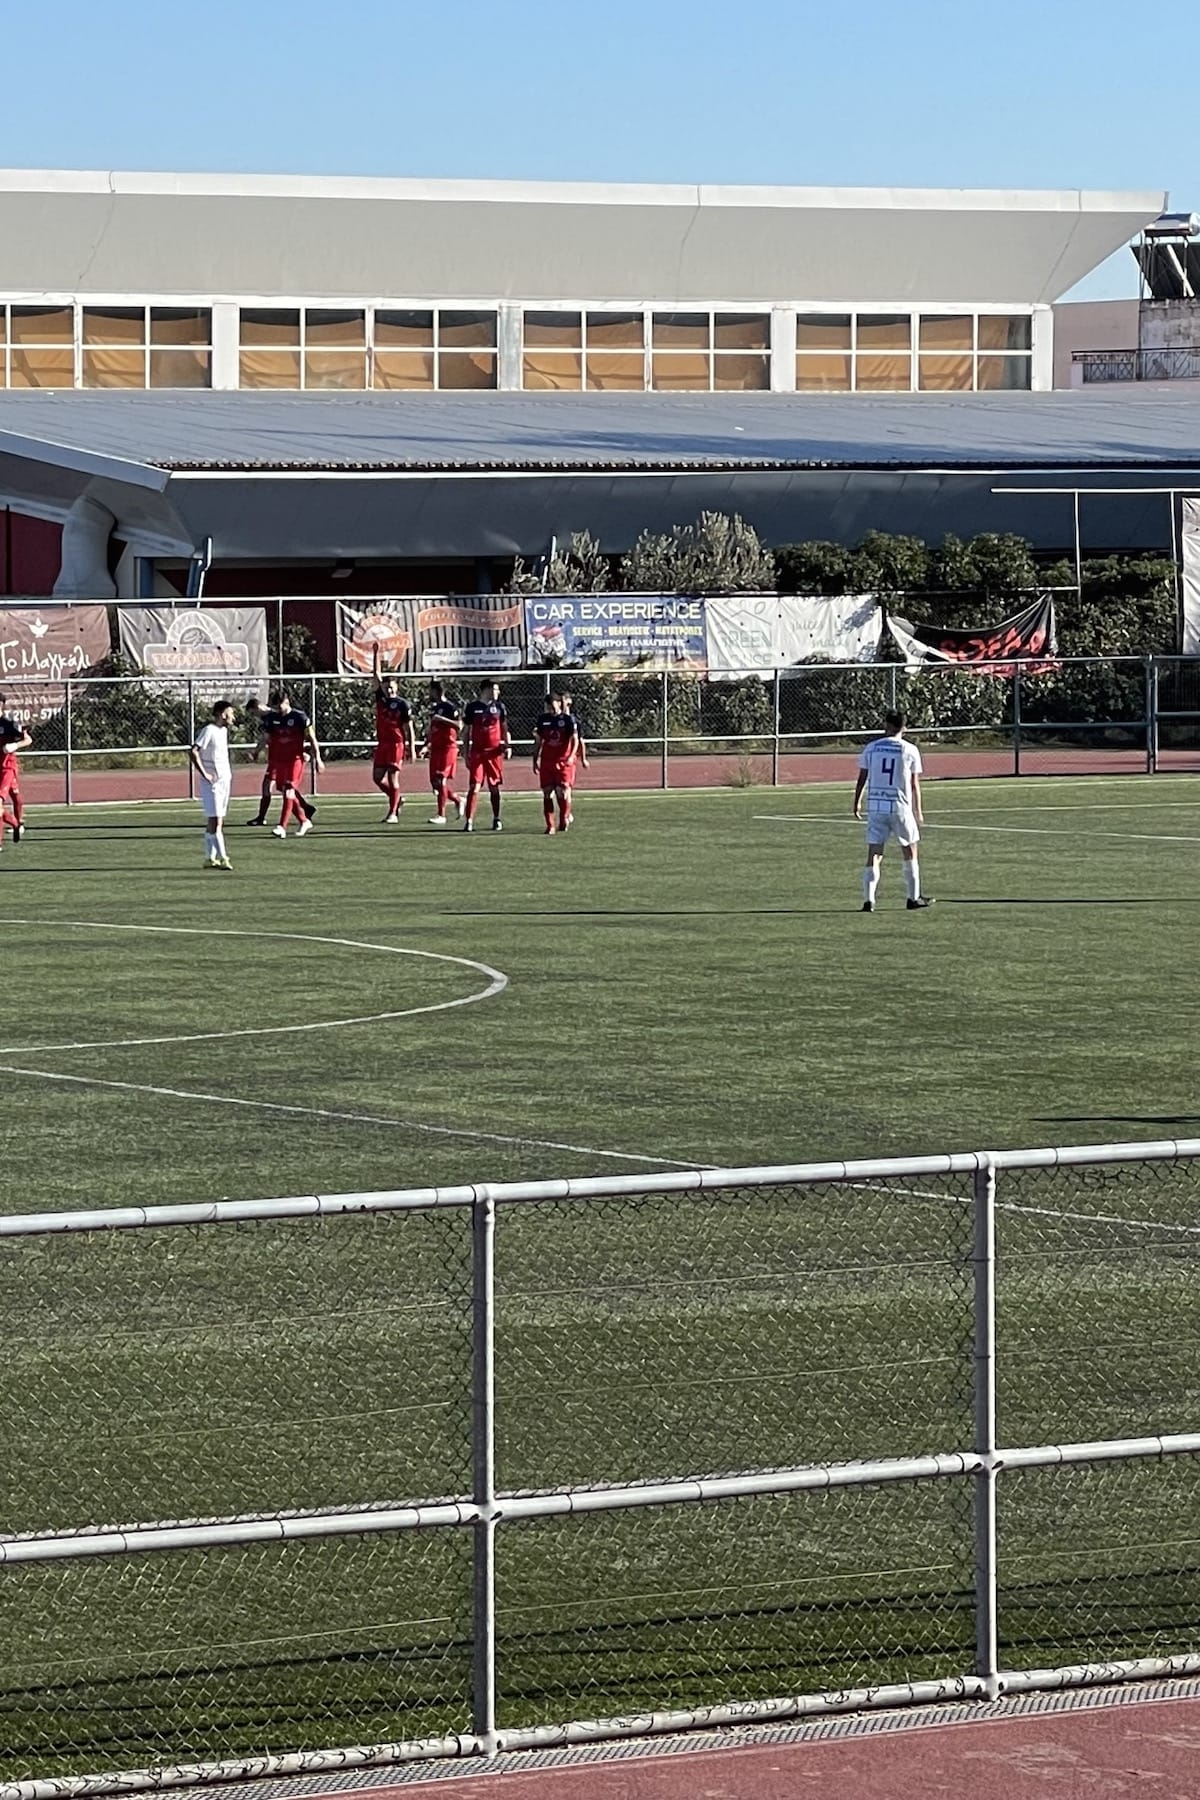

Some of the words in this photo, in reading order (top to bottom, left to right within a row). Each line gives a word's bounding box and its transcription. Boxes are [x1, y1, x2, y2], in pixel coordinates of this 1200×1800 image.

[533, 603, 575, 620] CAR
[580, 603, 702, 619] EXPERIENCE
[718, 630, 772, 648] GREEN
[22, 642, 91, 681] Μαγκάλι
[12, 708, 31, 721] 210
[882, 758, 896, 786] 4
